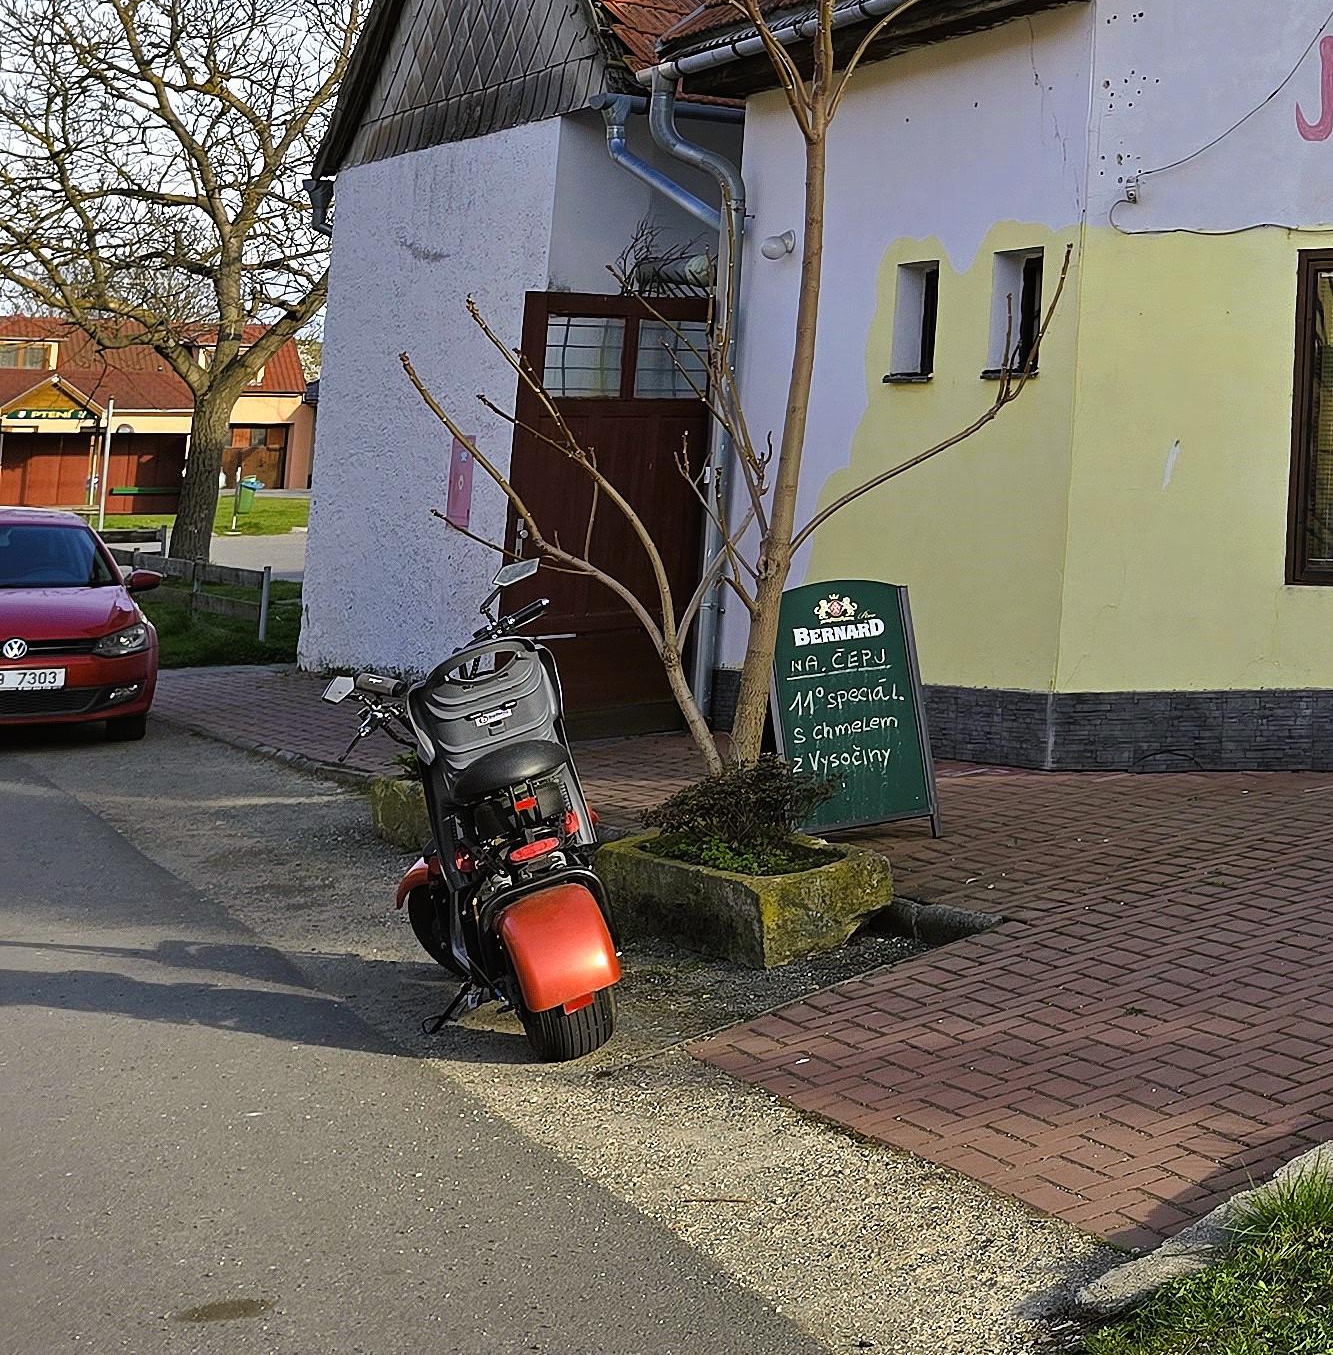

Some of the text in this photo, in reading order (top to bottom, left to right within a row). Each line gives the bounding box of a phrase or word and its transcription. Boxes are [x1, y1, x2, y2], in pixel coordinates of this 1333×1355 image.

[30, 409, 75, 418] PTENÍ
[793, 618, 885, 646] BERNARD
[832, 648, 887, 669] ČEPU
[17, 671, 58, 686] 7303
